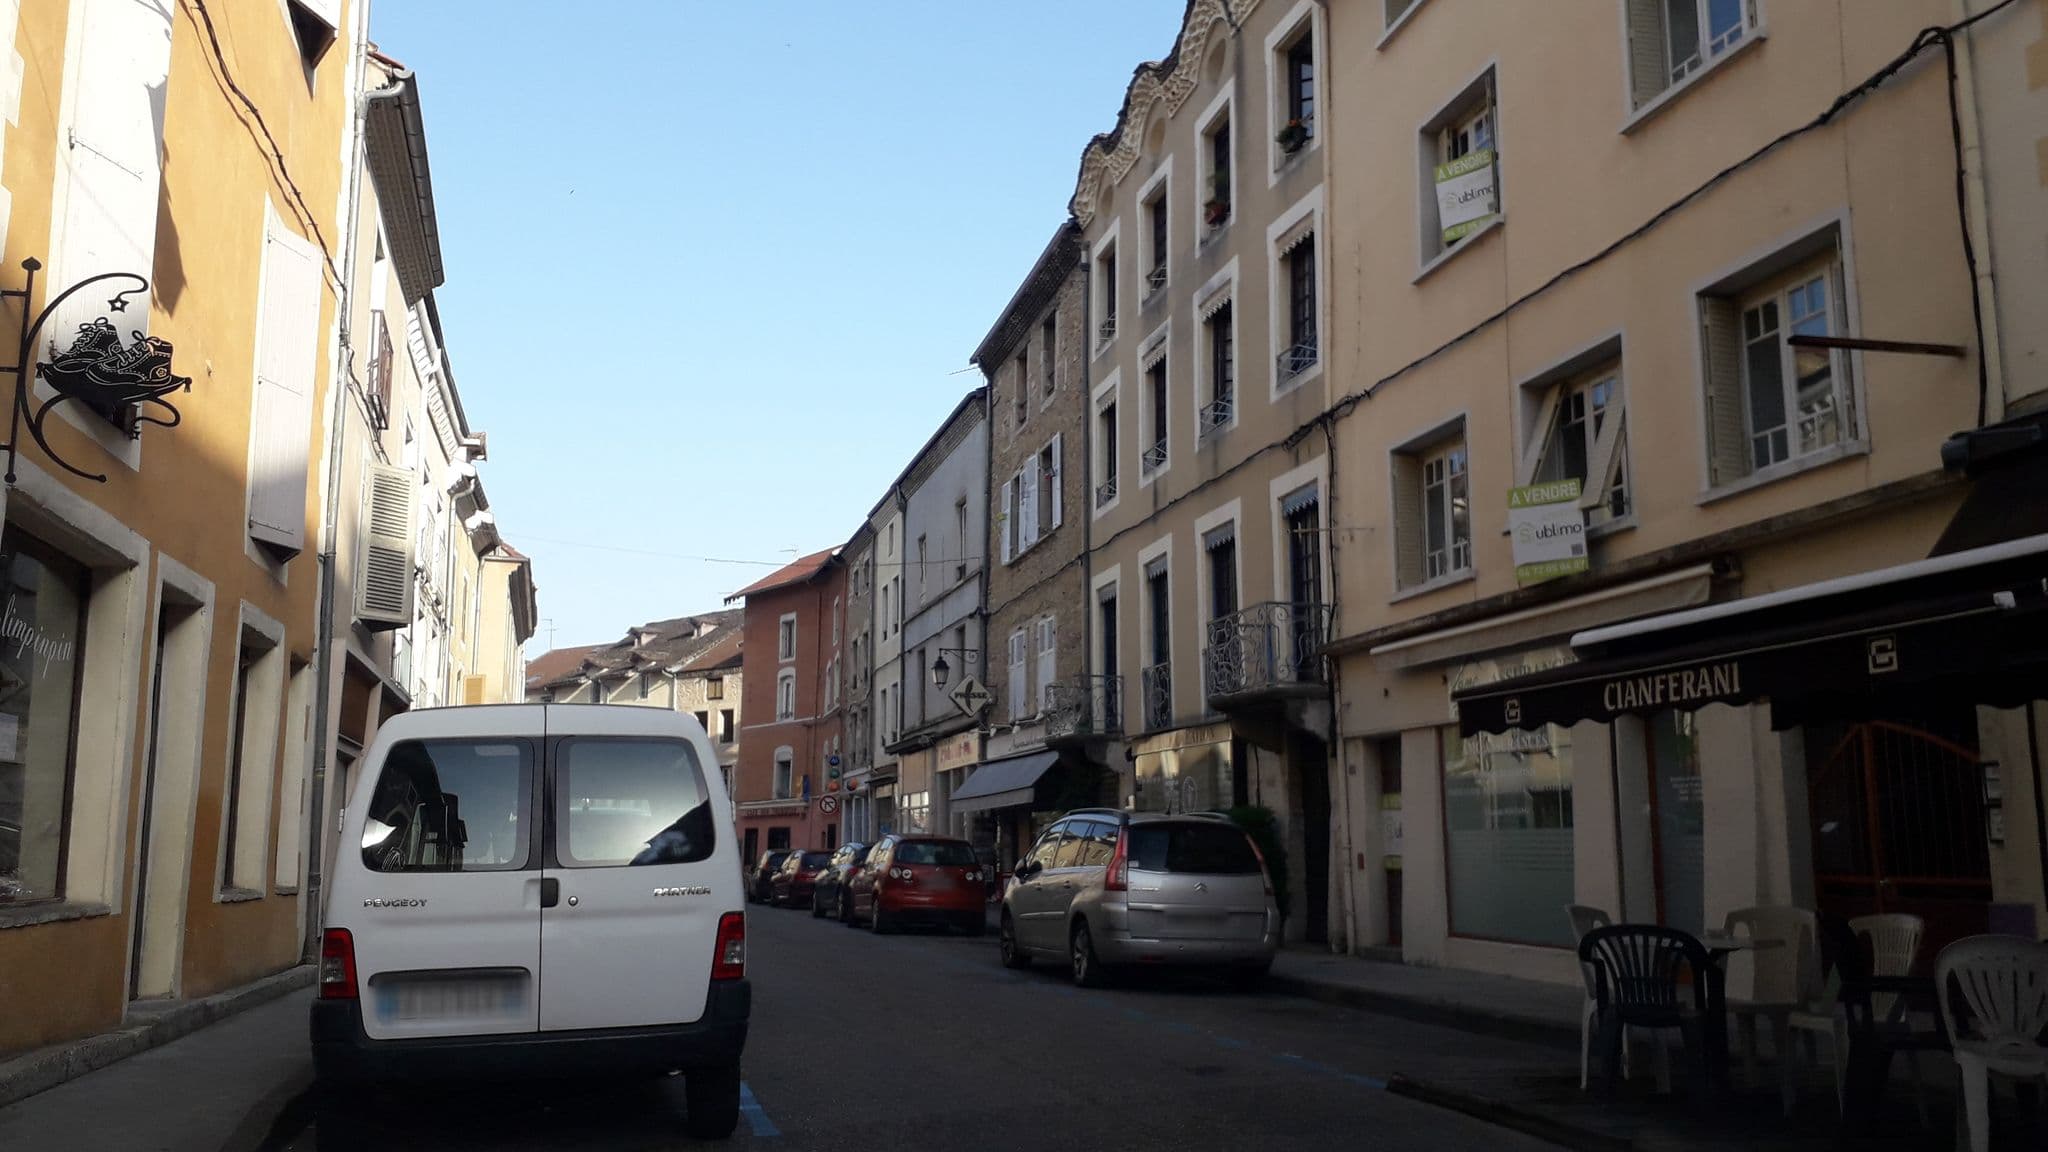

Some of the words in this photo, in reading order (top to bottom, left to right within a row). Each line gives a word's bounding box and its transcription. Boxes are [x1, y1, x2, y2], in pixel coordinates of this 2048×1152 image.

[1447, 152, 1490, 176] VENDRE
[1511, 491, 1521, 505] A
[1522, 481, 1579, 503] VENDRE
[0, 593, 72, 680] limpinpin
[1603, 661, 1741, 712] CIANFERANI
[363, 899, 427, 907] PEUGEOT
[654, 887, 711, 896] PARTNER
